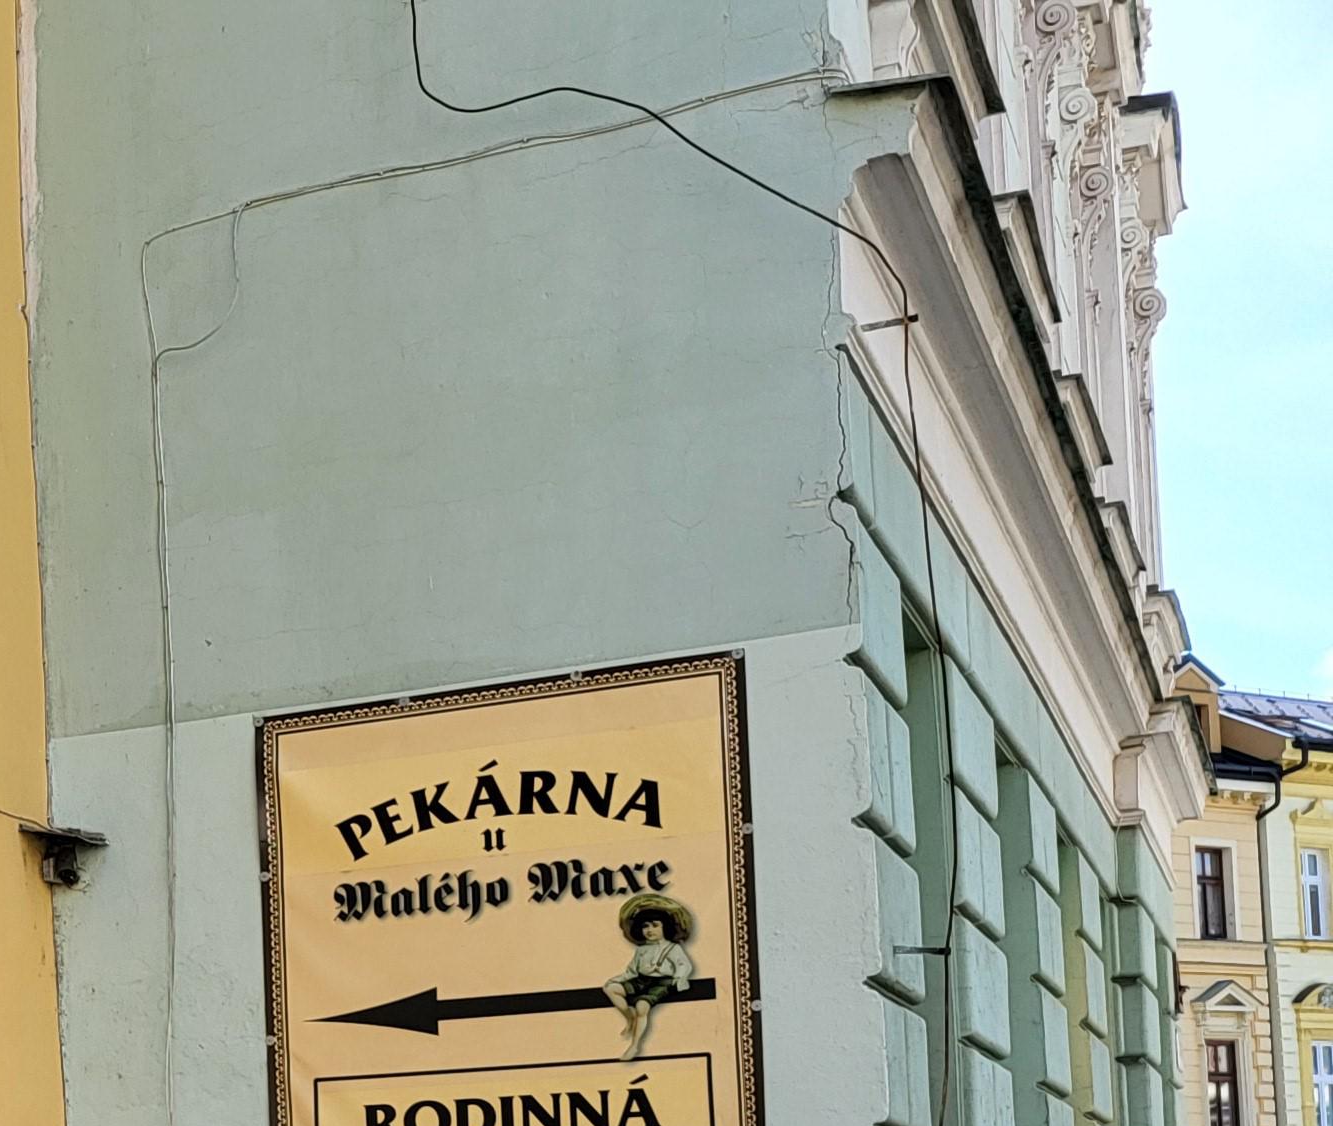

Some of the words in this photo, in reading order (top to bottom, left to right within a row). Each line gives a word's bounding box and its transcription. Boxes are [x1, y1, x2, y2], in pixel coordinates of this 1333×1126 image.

[334, 758, 664, 861] PEKÁRNA
[481, 826, 507, 852] u
[333, 869, 510, 924] Malého
[528, 858, 671, 903] Maxe
